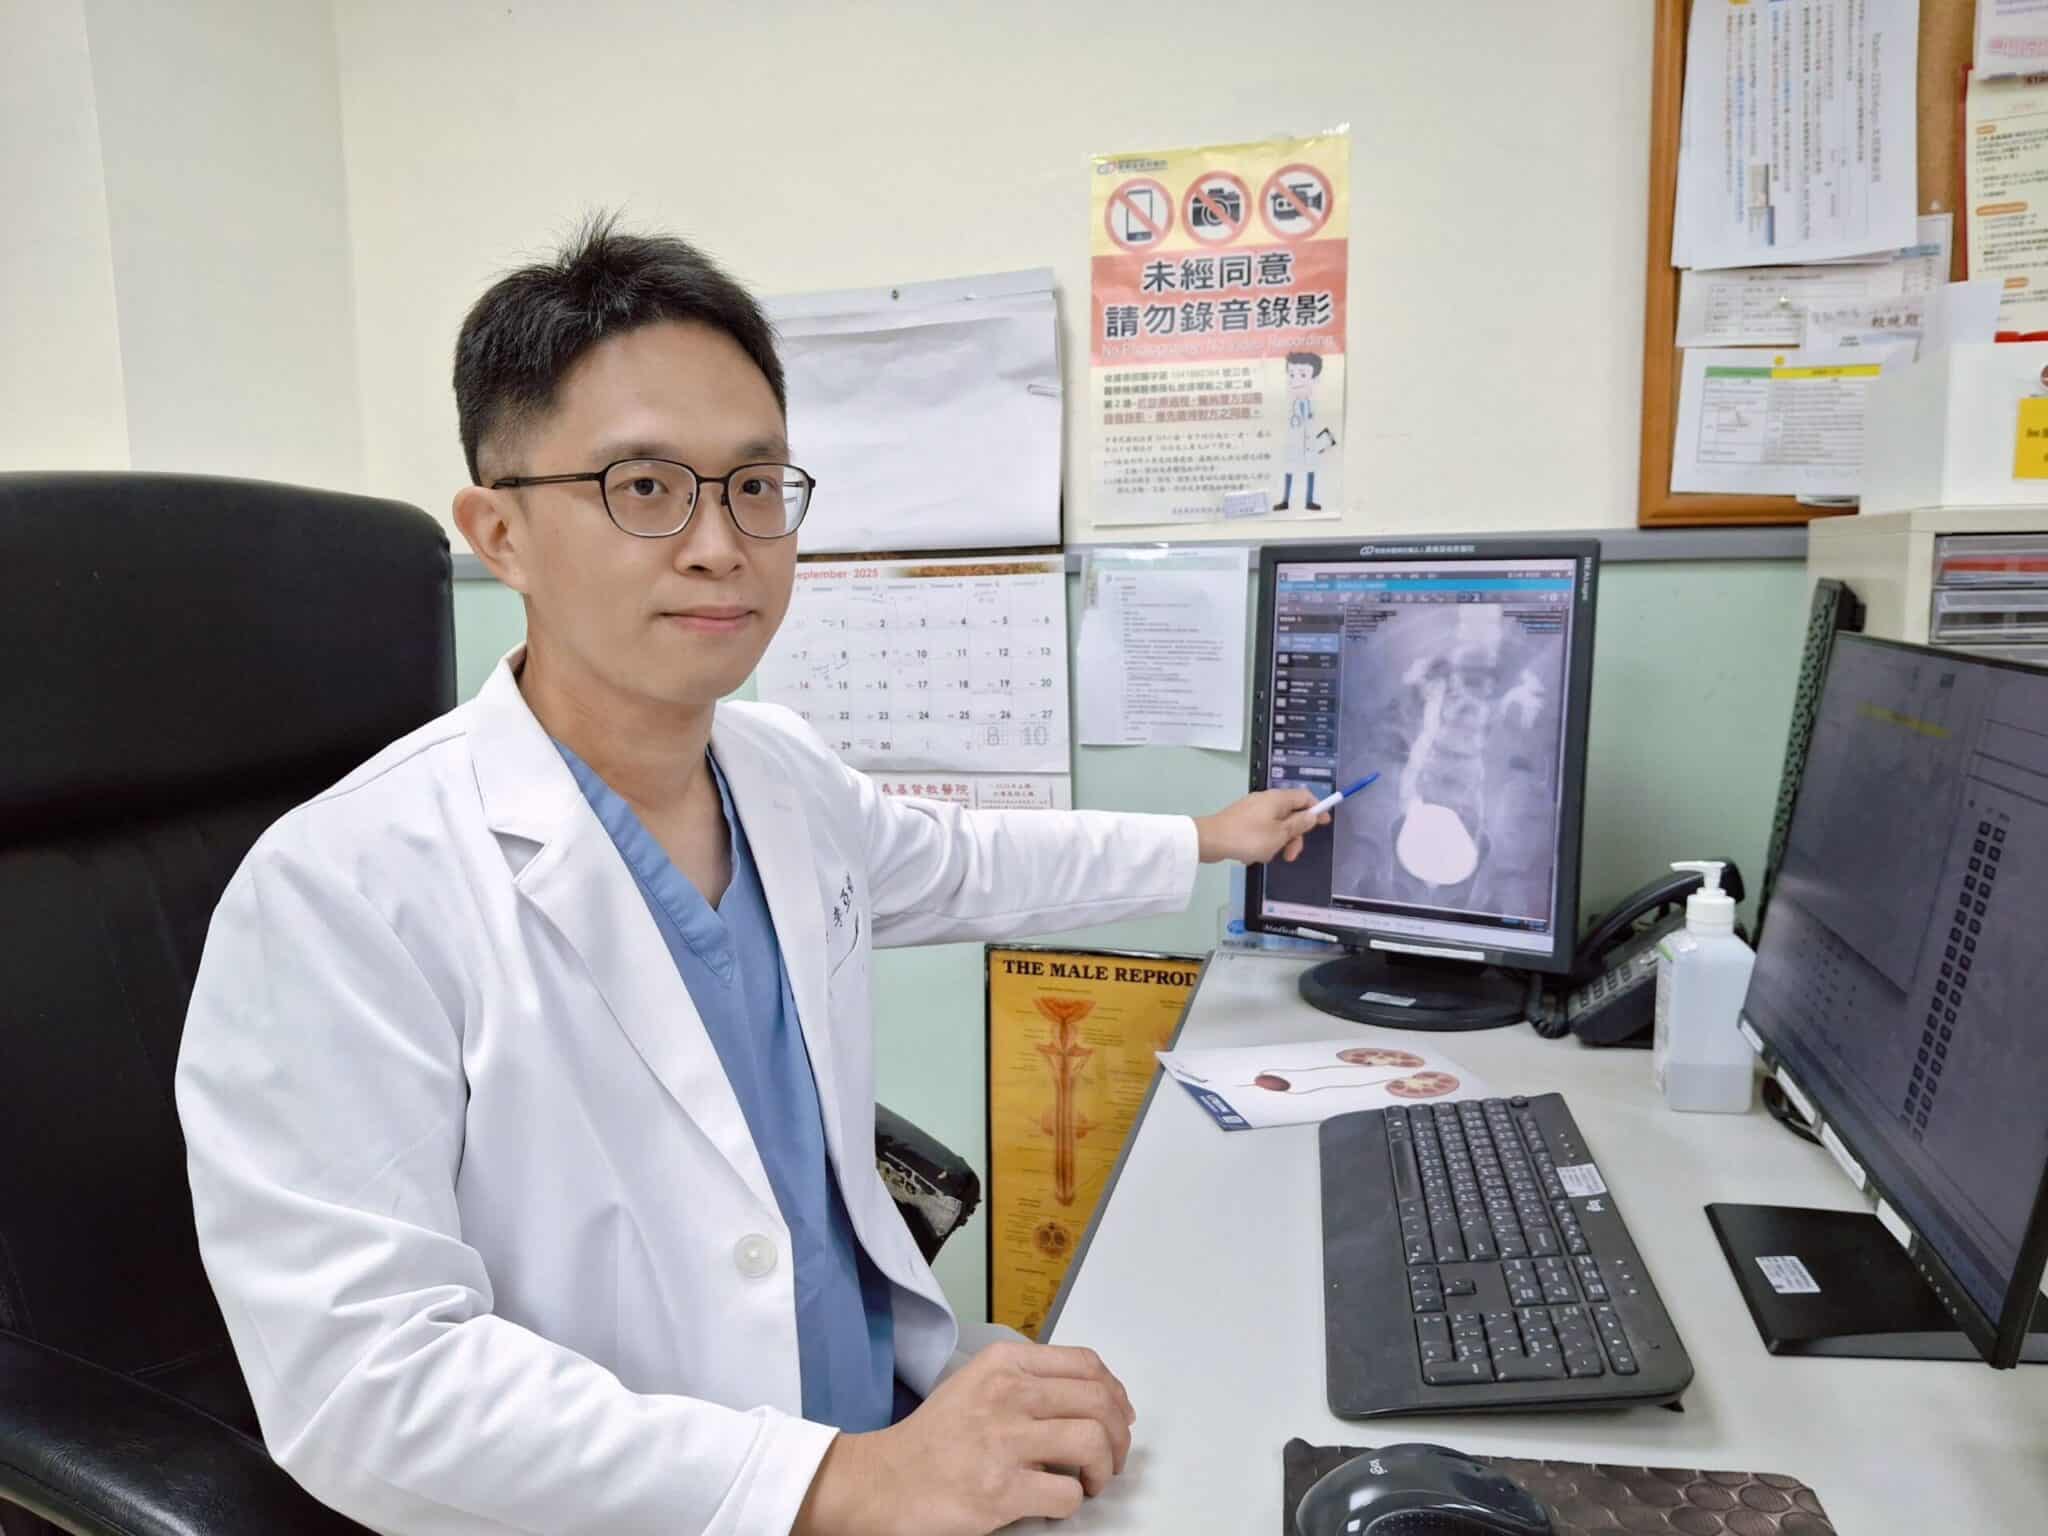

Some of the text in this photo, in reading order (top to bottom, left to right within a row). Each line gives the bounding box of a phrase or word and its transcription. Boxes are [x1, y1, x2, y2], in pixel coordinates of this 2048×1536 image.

[1143, 252, 1293, 293] 未經同意
[1105, 294, 1331, 337] 請勿錄音錄影
[796, 567, 880, 581] eptember 2025
[917, 648, 928, 659] 10
[957, 647, 967, 657] 11
[999, 647, 1009, 657] 12
[1040, 647, 1052, 657] 13
[799, 678, 1053, 690] 14 15 16 17 18 19 20
[839, 711, 850, 721] 22
[879, 711, 889, 721] 23
[919, 711, 930, 721] 24
[959, 710, 970, 721] 25
[1000, 709, 1012, 720] 26
[1041, 709, 1054, 720] 27
[841, 740, 852, 751] 29
[880, 740, 892, 751] 30
[1003, 959, 1045, 976] THE
[1050, 963, 1109, 981] MALE
